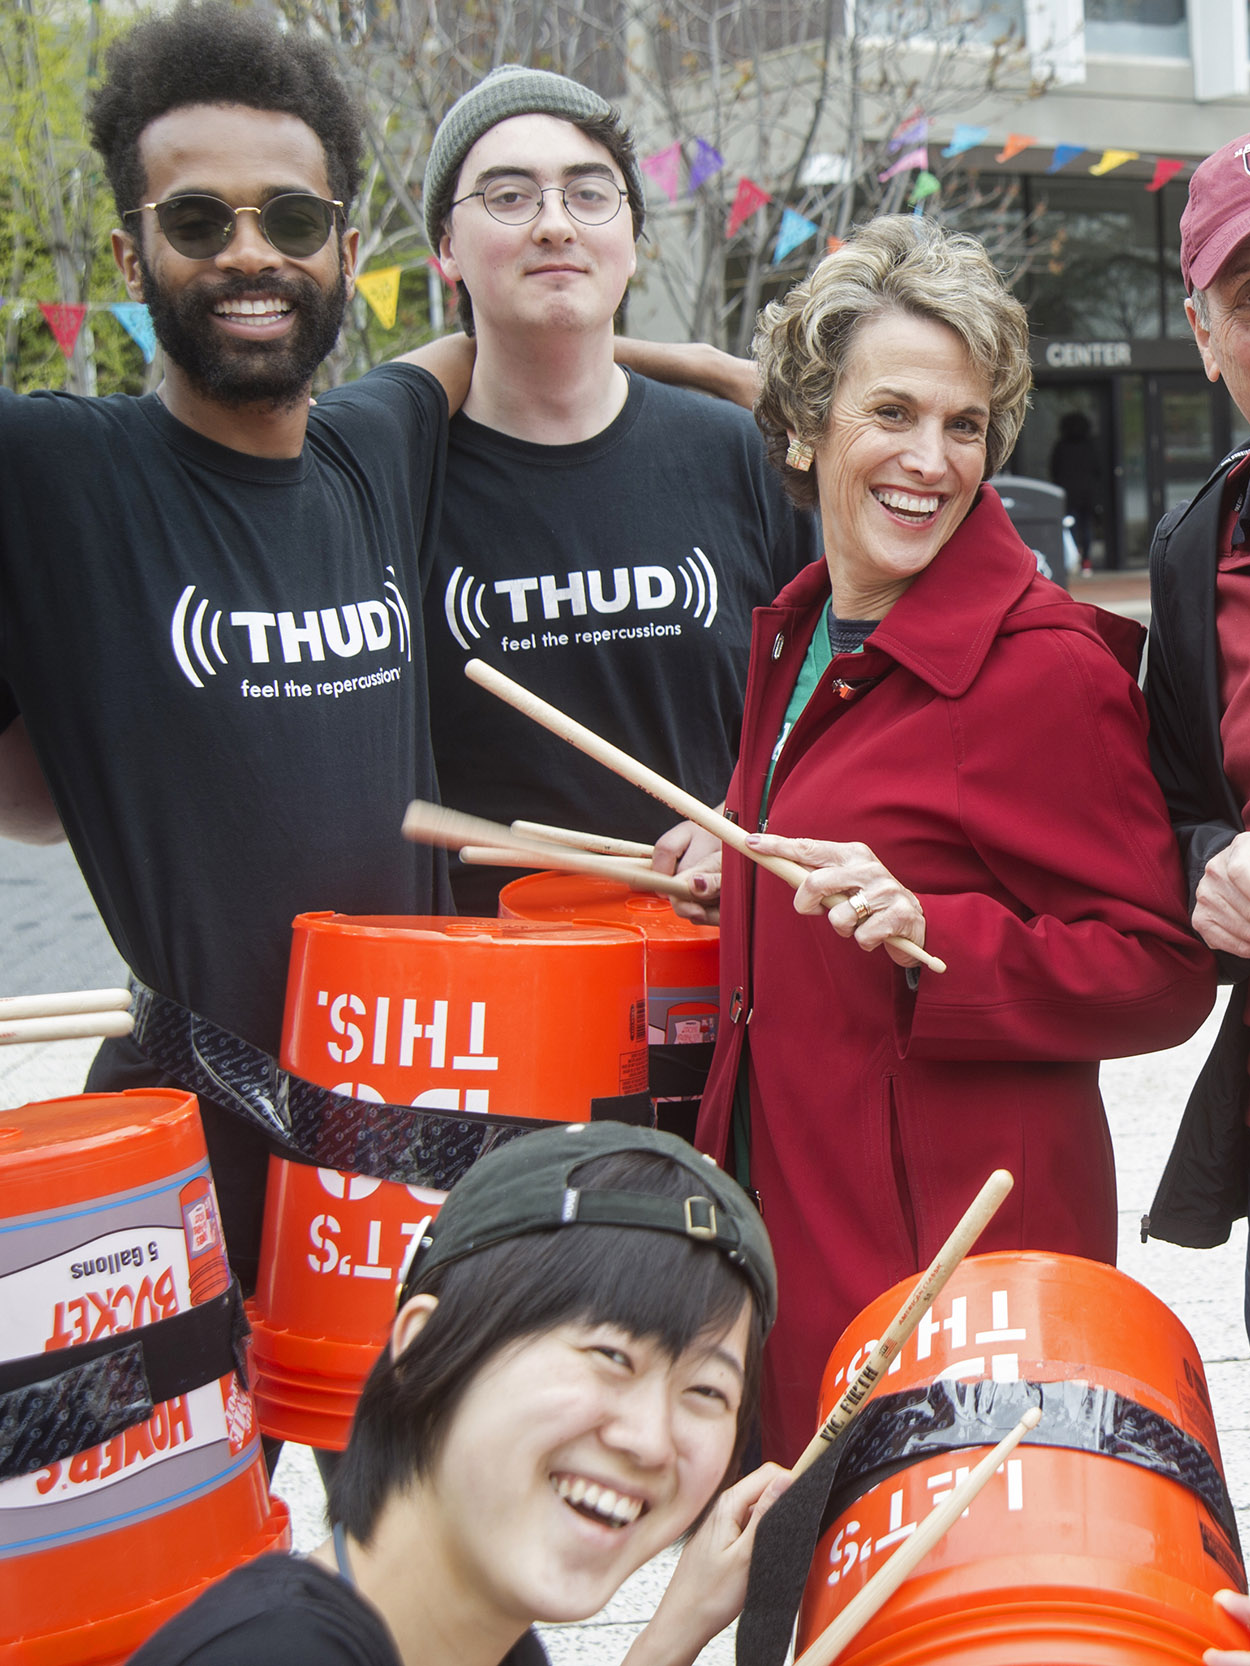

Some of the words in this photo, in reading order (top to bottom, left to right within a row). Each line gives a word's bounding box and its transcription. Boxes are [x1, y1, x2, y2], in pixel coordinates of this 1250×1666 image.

[1046, 342, 1132, 367] CENTER
[494, 565, 677, 624] THUD
[230, 600, 392, 664] THUD
[501, 633, 537, 652] feel
[541, 630, 569, 648] the
[575, 622, 682, 646] repercussions
[240, 679, 280, 698] feel
[284, 679, 312, 697] the
[316, 666, 401, 699] repercussion
[317, 990, 498, 1070] THIS.
[70, 1246, 144, 1279] Gallons
[148, 1241, 159, 1261] 5
[308, 1214, 420, 1284] T'S
[45, 1265, 180, 1353] BUCKET
[819, 1418, 846, 1444] VIC
[842, 1363, 879, 1415] FIRTH
